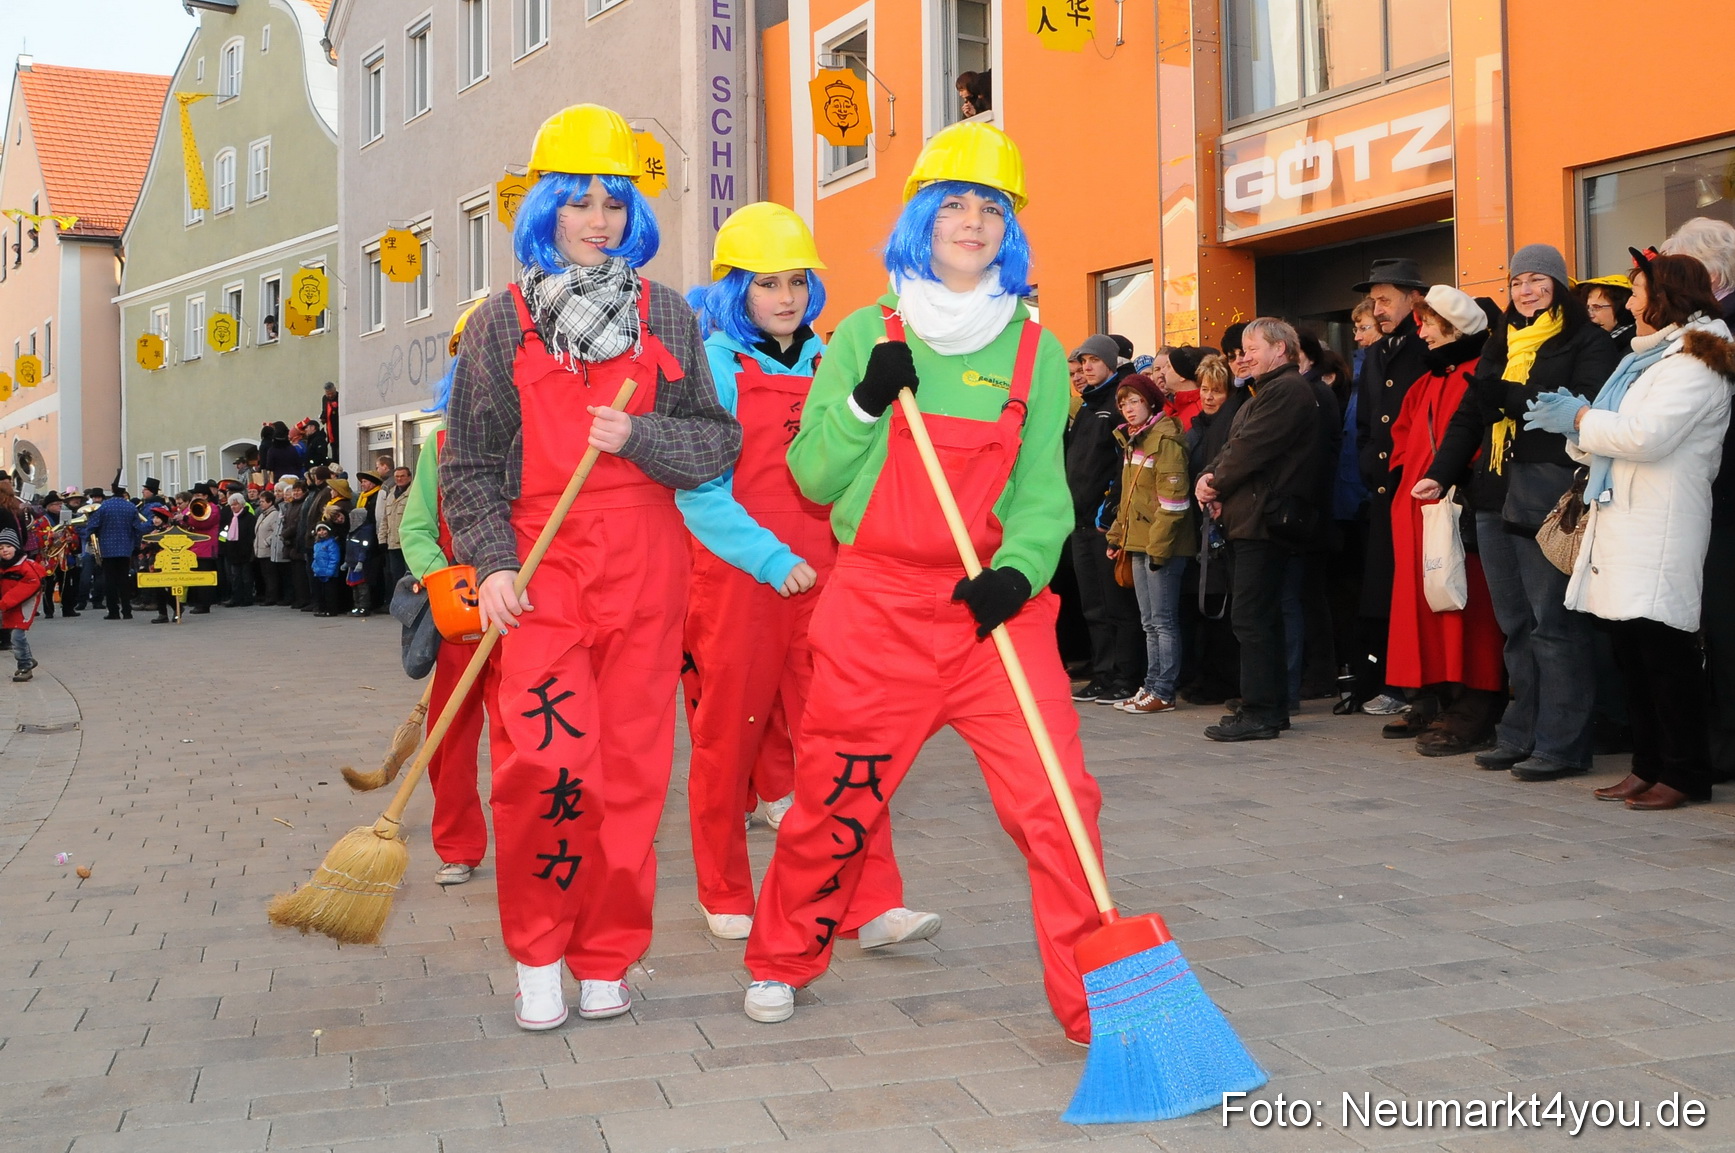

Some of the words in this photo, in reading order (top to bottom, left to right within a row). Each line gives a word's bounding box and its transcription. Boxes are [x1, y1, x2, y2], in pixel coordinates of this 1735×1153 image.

[1037, 6, 1058, 34] 人
[645, 157, 665, 180] 华
[1224, 104, 1452, 213] GÖTZ
[387, 265, 396, 275] 人
[408, 331, 453, 386] OPT
